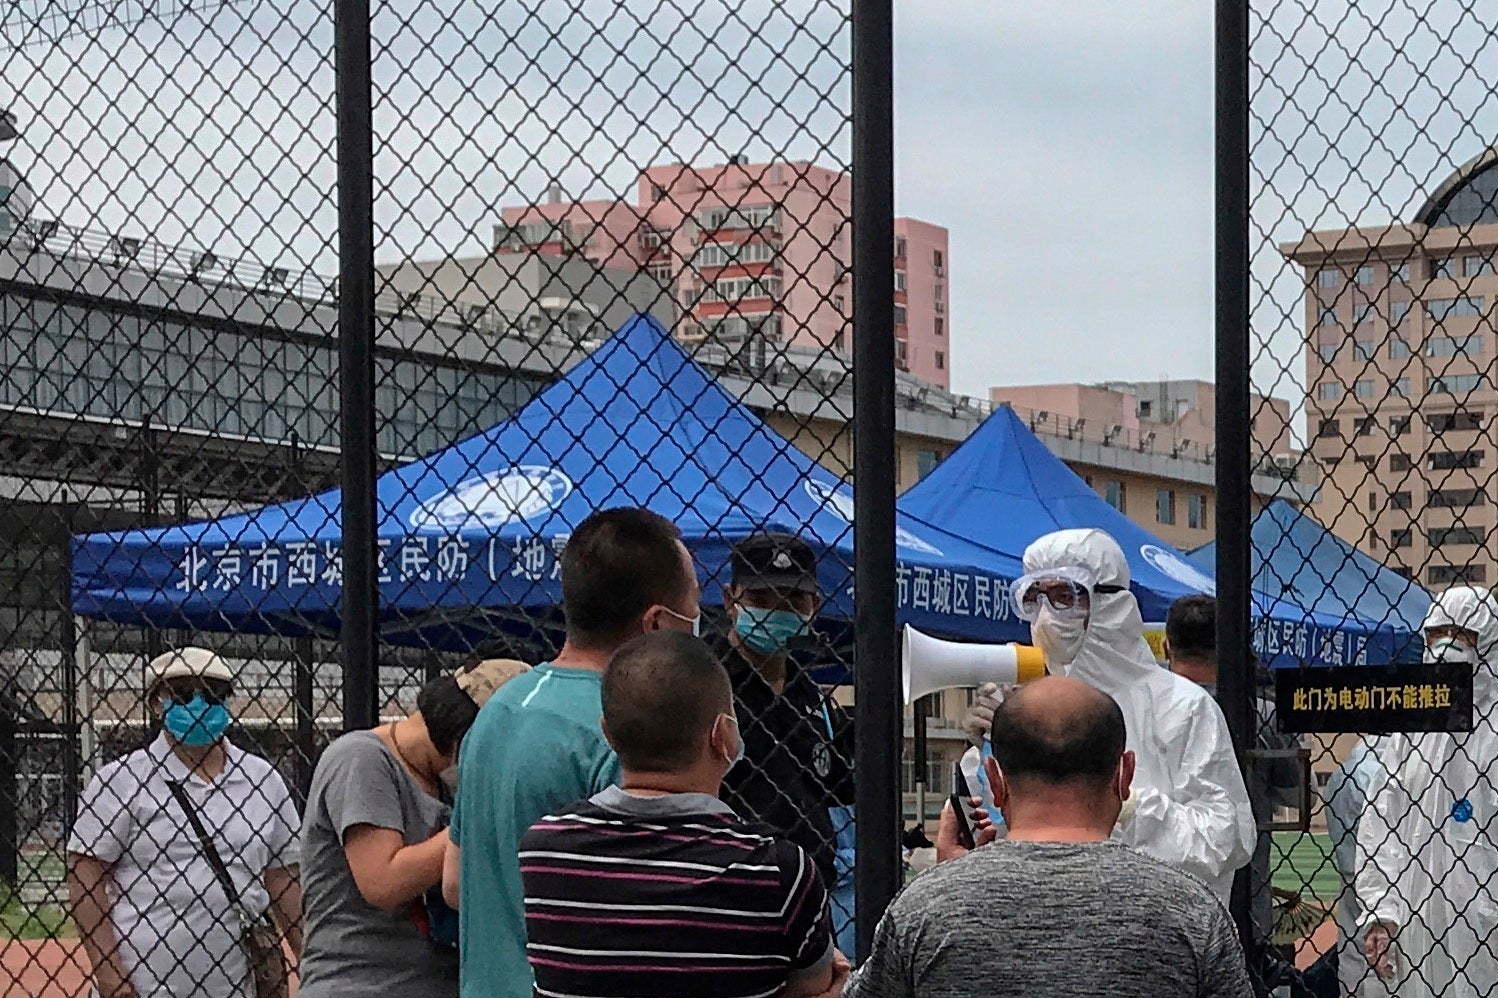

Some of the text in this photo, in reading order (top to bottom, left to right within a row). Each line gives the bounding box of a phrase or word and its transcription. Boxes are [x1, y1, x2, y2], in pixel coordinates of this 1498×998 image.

[1293, 684, 1452, 711] 此门为电动门不能推拉
